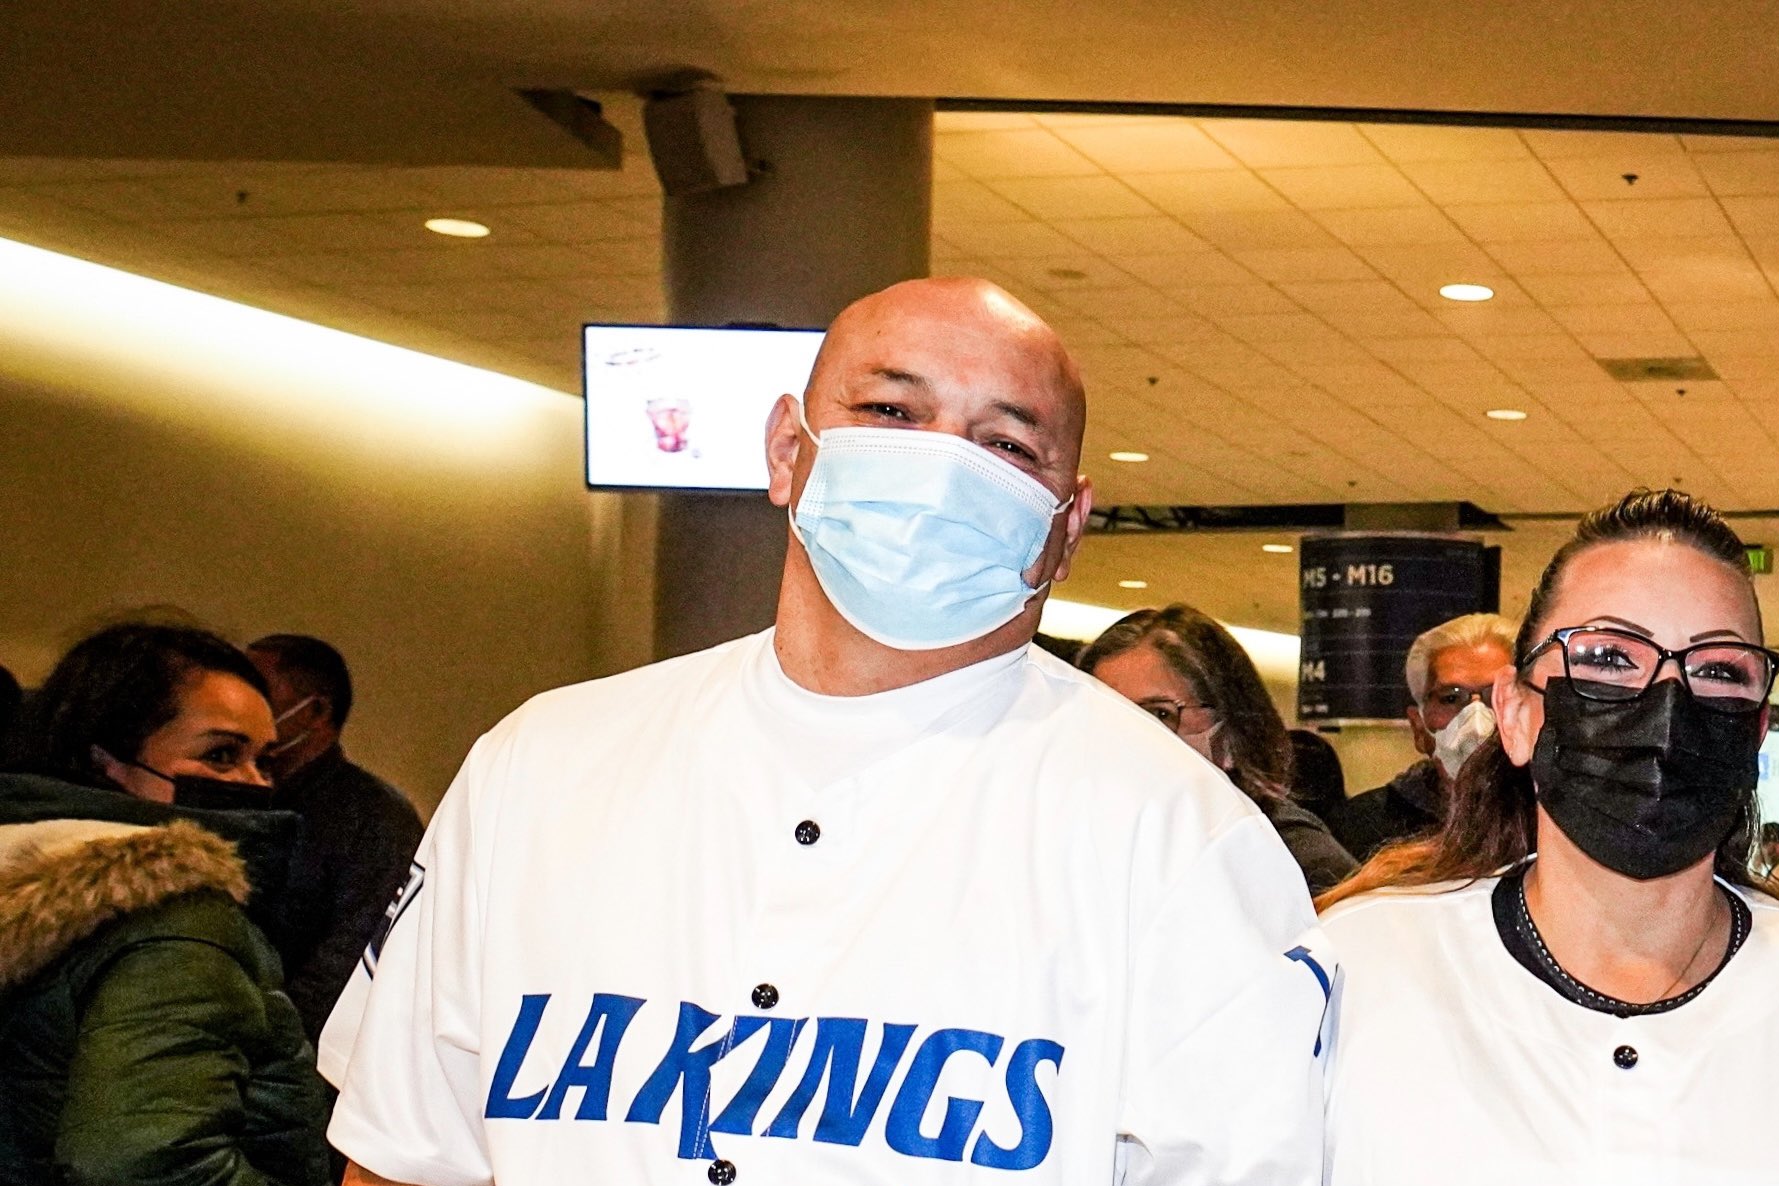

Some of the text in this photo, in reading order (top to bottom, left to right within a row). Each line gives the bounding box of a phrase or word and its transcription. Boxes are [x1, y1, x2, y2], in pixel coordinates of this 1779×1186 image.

[1347, 564, 1394, 586] M16
[1301, 660, 1325, 682] M4
[484, 993, 1065, 1171] LA KINGS
